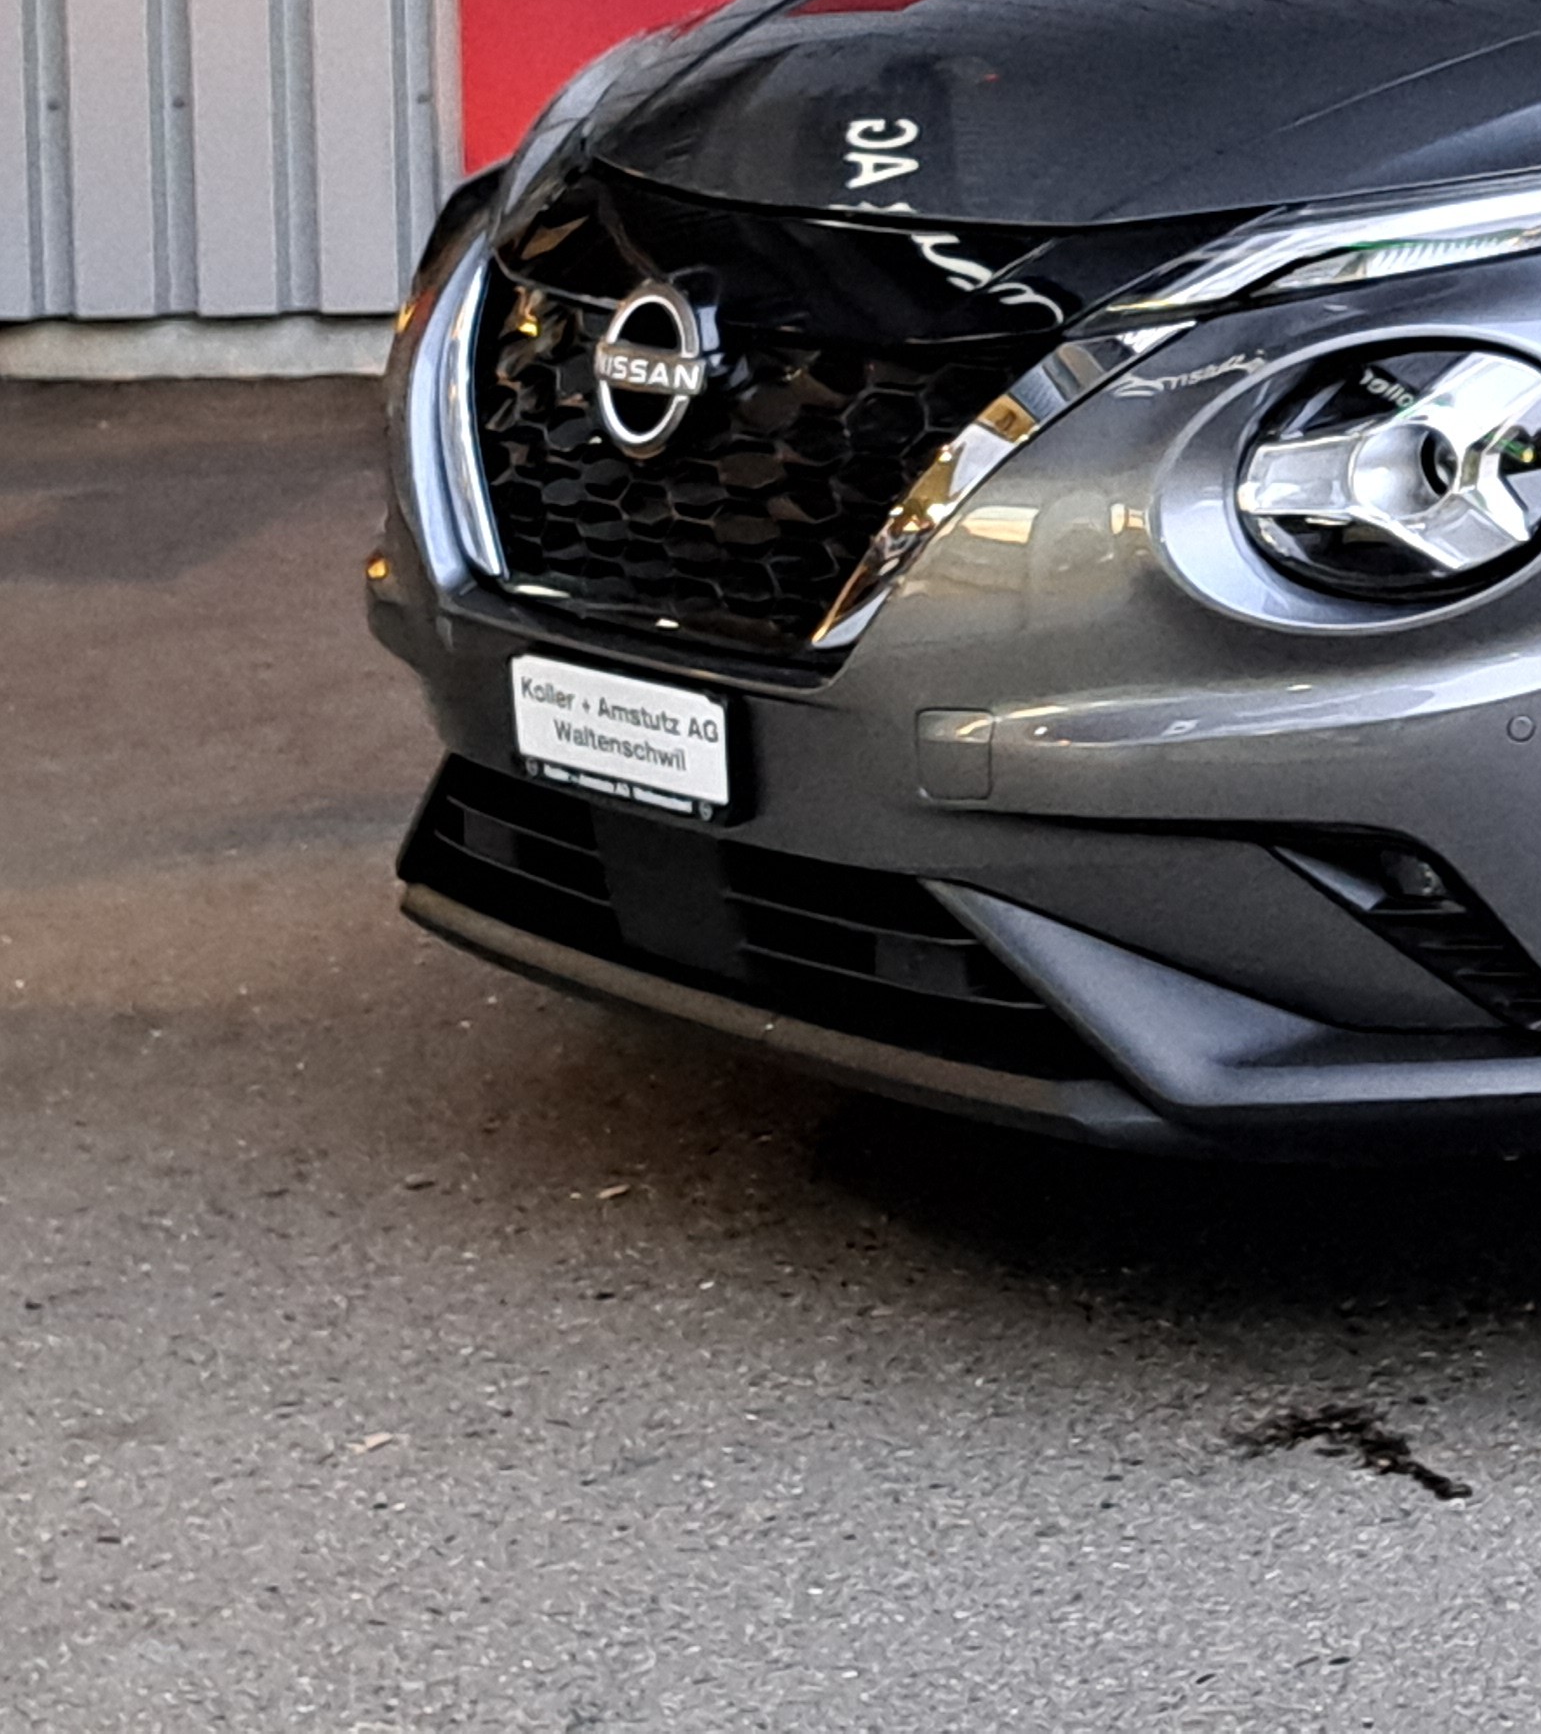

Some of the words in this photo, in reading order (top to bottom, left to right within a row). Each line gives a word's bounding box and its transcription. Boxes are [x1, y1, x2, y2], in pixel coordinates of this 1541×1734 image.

[520, 677, 575, 711] Koller
[598, 697, 681, 736] Amstutz
[688, 717, 719, 743] AG
[553, 719, 687, 771] Waltenschwil
